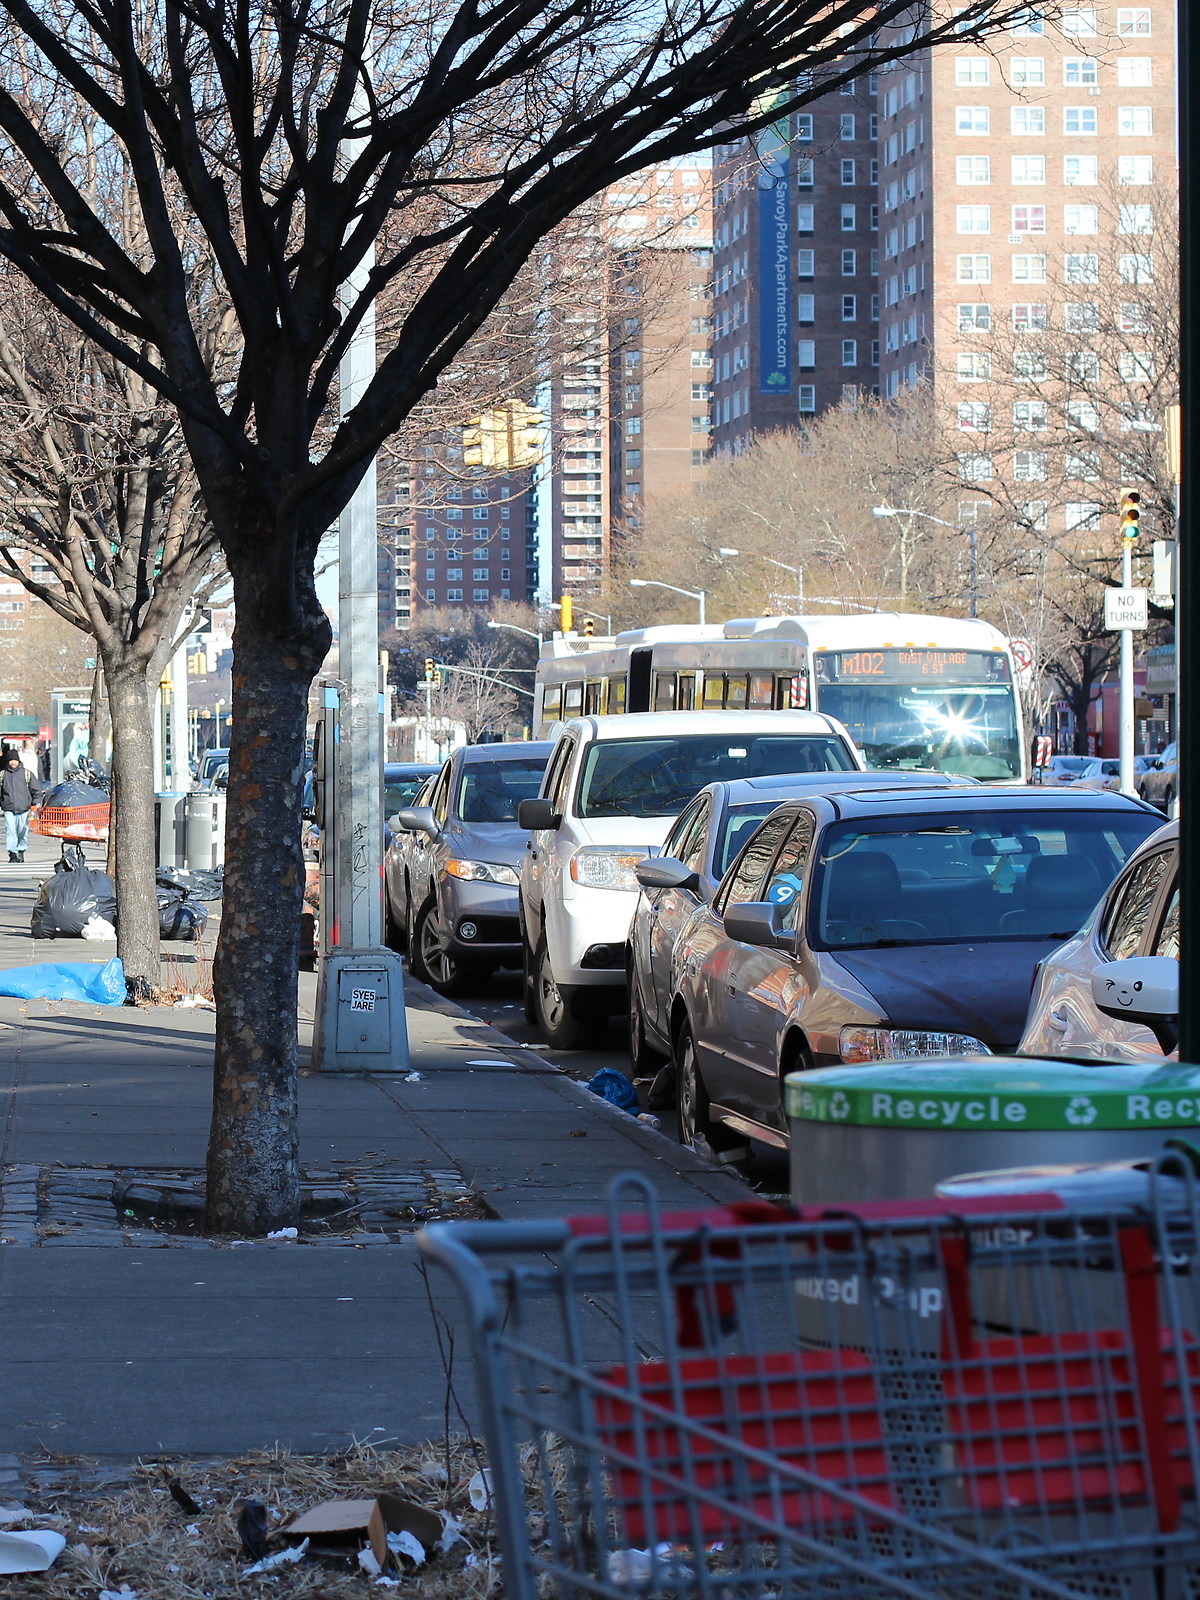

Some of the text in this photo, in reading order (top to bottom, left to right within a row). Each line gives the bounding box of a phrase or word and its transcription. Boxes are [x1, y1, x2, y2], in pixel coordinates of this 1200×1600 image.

[774, 181, 788, 367] SavoyParkApartments.com
[1117, 596, 1134, 607] NO
[1109, 612, 1145, 622] TURNS
[843, 652, 968, 675] M102 EAST VILLAGE
[921, 663, 944, 674] 6 ST
[352, 1000, 374, 1011] JARE
[871, 1092, 1200, 1124] Recycle Rec
